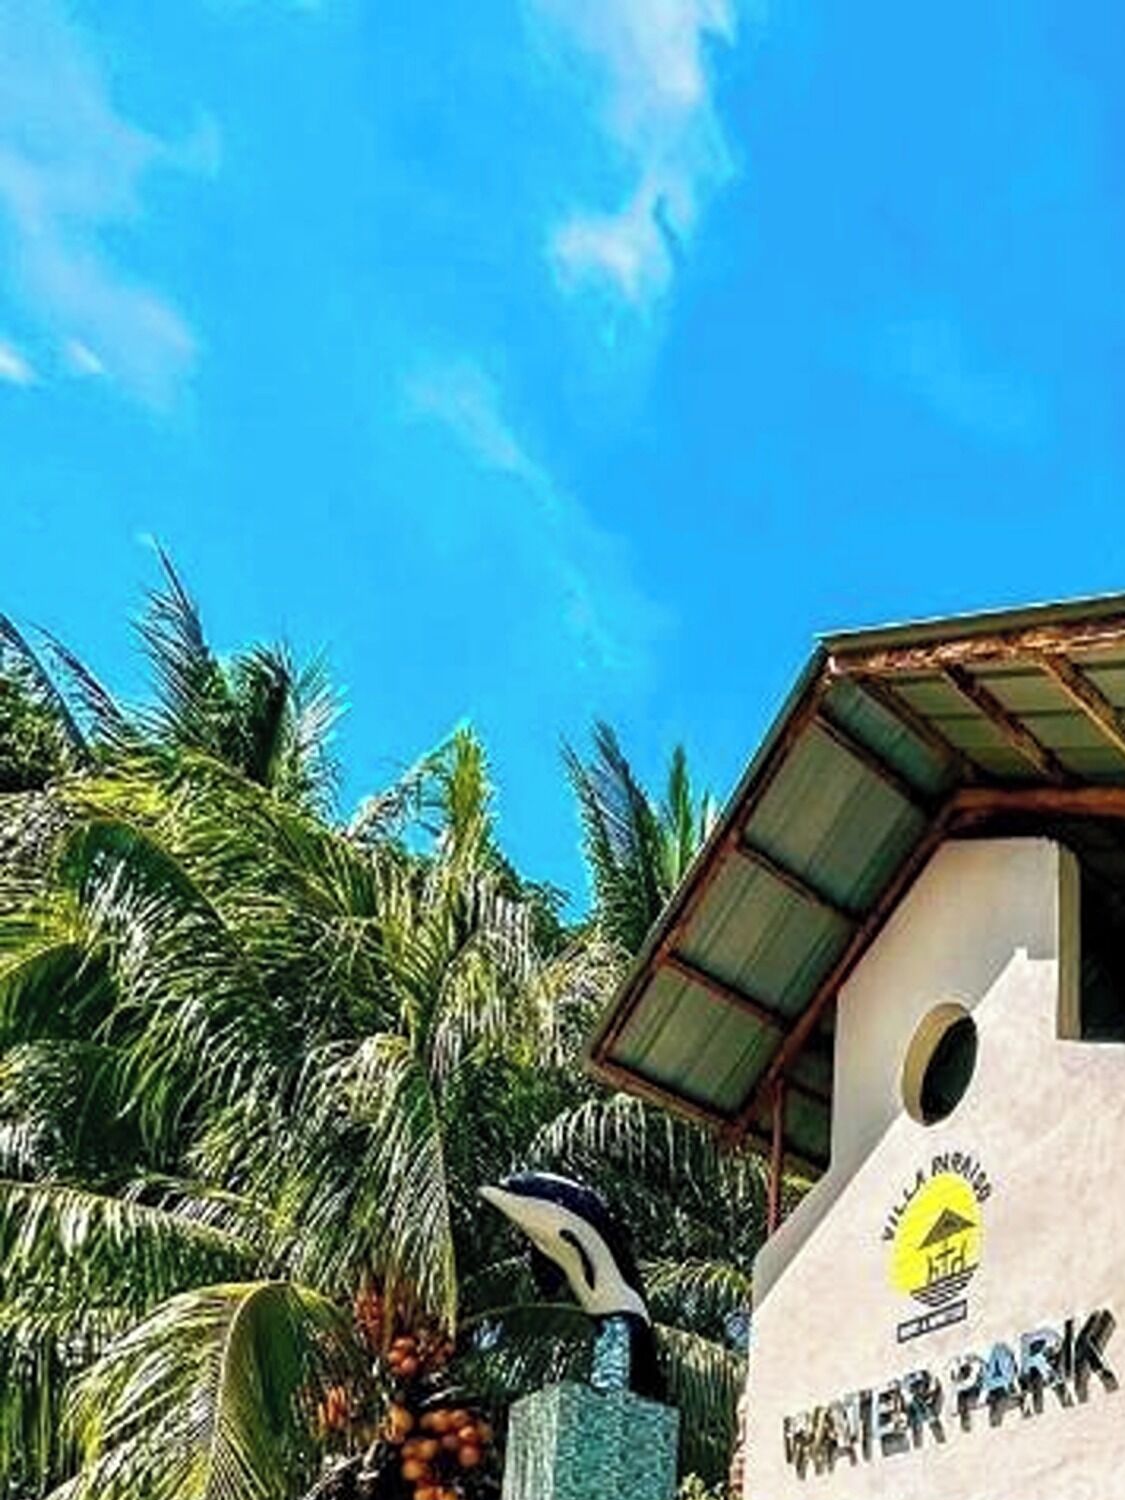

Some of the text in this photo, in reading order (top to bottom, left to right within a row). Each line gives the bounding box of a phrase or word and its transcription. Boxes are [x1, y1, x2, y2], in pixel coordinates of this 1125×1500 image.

[881, 1168, 926, 1241] VILLA
[783, 1308, 1120, 1480] WATER PARK
